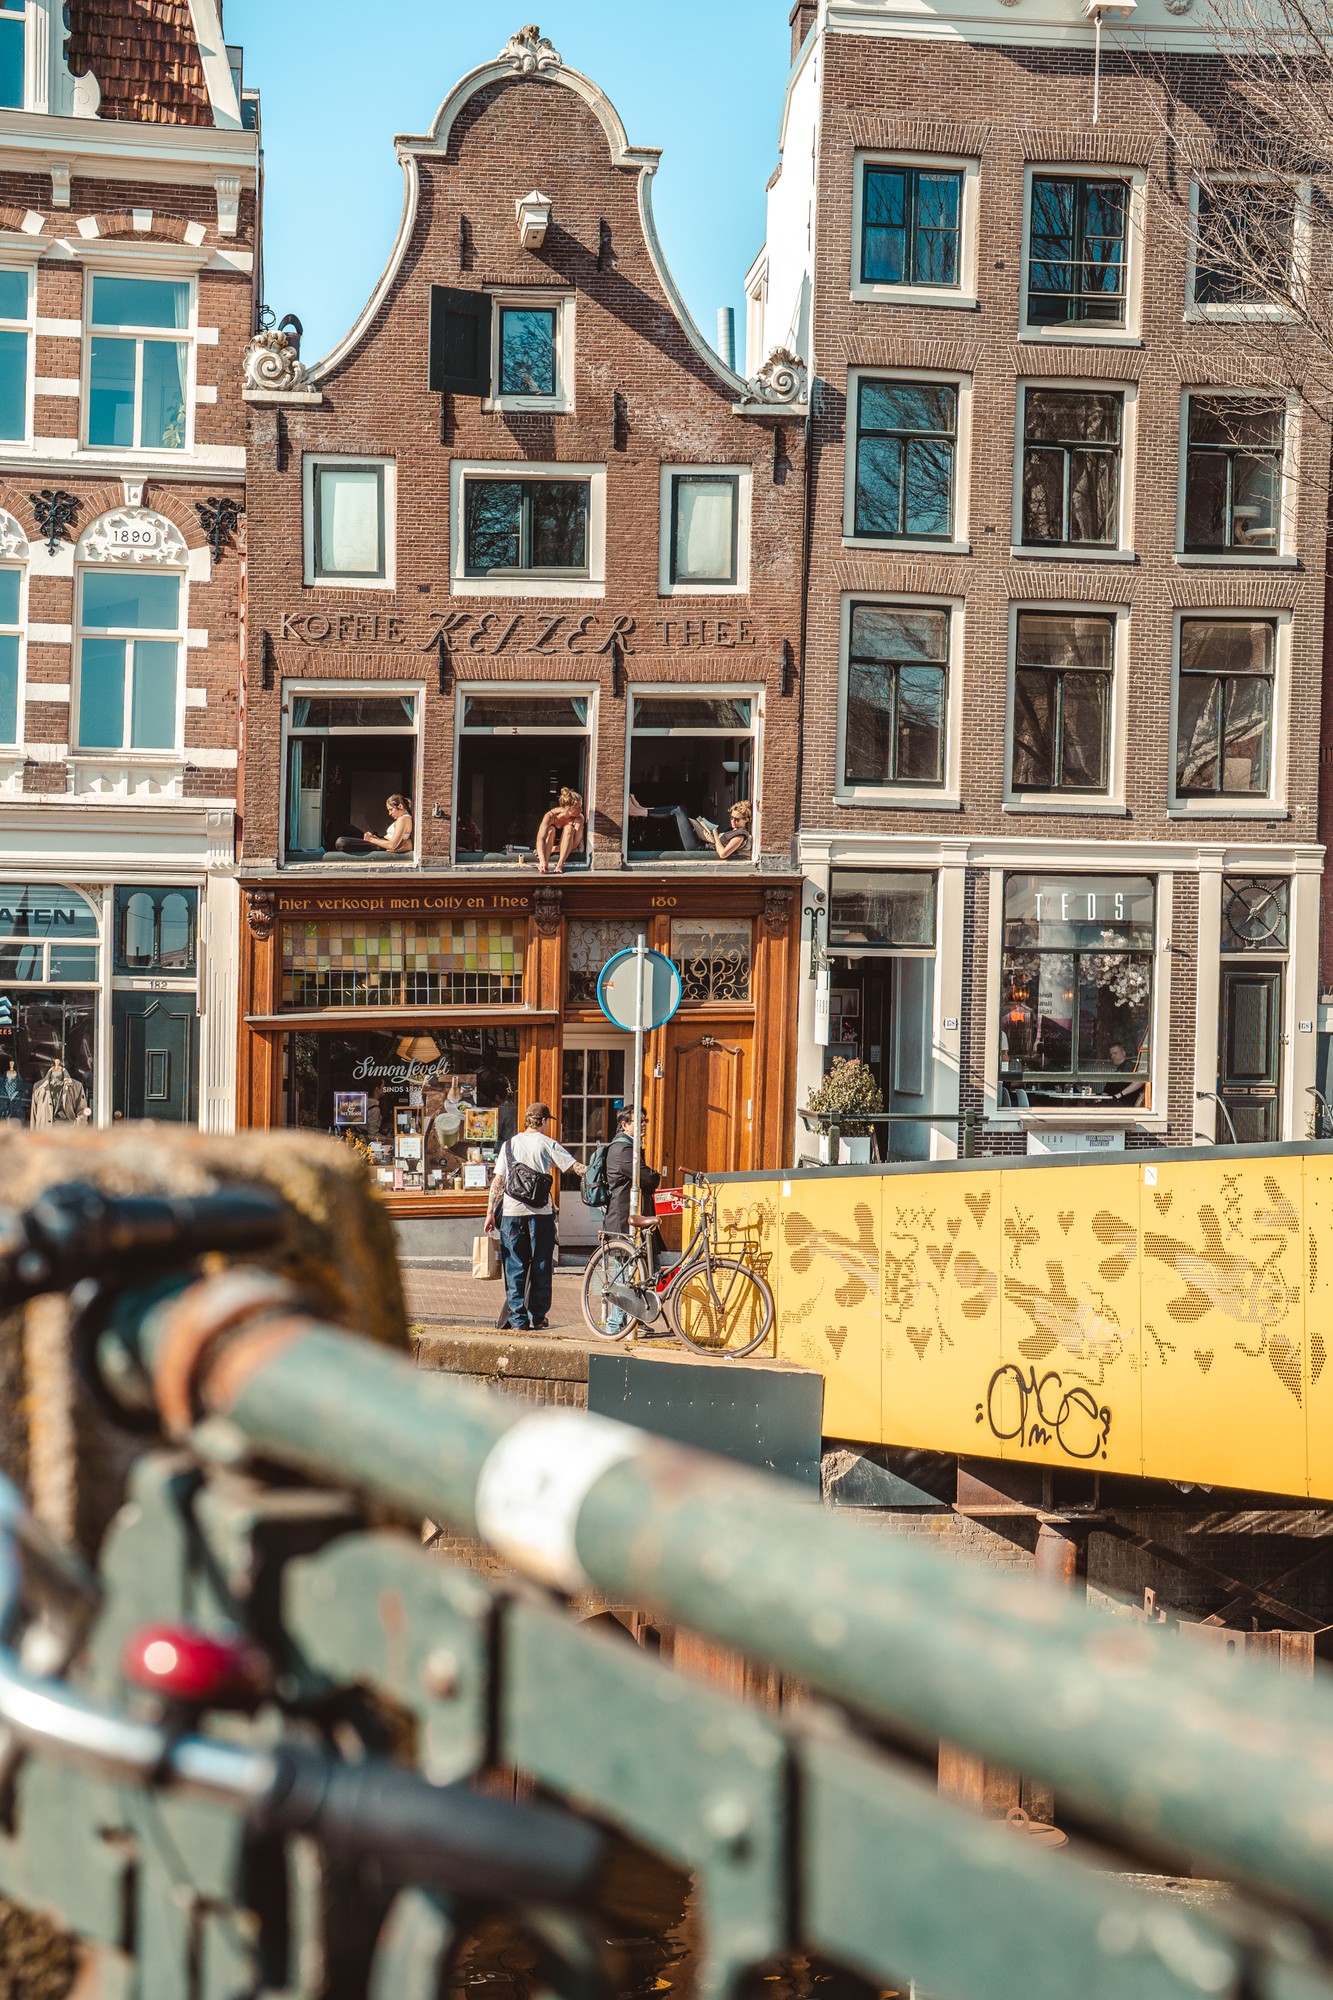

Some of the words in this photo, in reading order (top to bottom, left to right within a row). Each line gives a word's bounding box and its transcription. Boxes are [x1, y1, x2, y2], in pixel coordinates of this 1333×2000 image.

[114, 530, 151, 543] 1890
[279, 612, 404, 648] KOFFIE
[417, 611, 636, 655] KEIZER
[655, 619, 756, 648] THEE
[316, 897, 385, 911] verkoopt
[390, 898, 420, 909] men
[467, 897, 485, 908] en
[491, 895, 529, 908] Thee
[651, 896, 678, 907] 180
[1034, 893, 1123, 922] TEDS
[0, 908, 75, 925] ATEN
[149, 980, 168, 990] 182
[352, 1056, 408, 1080] Simon
